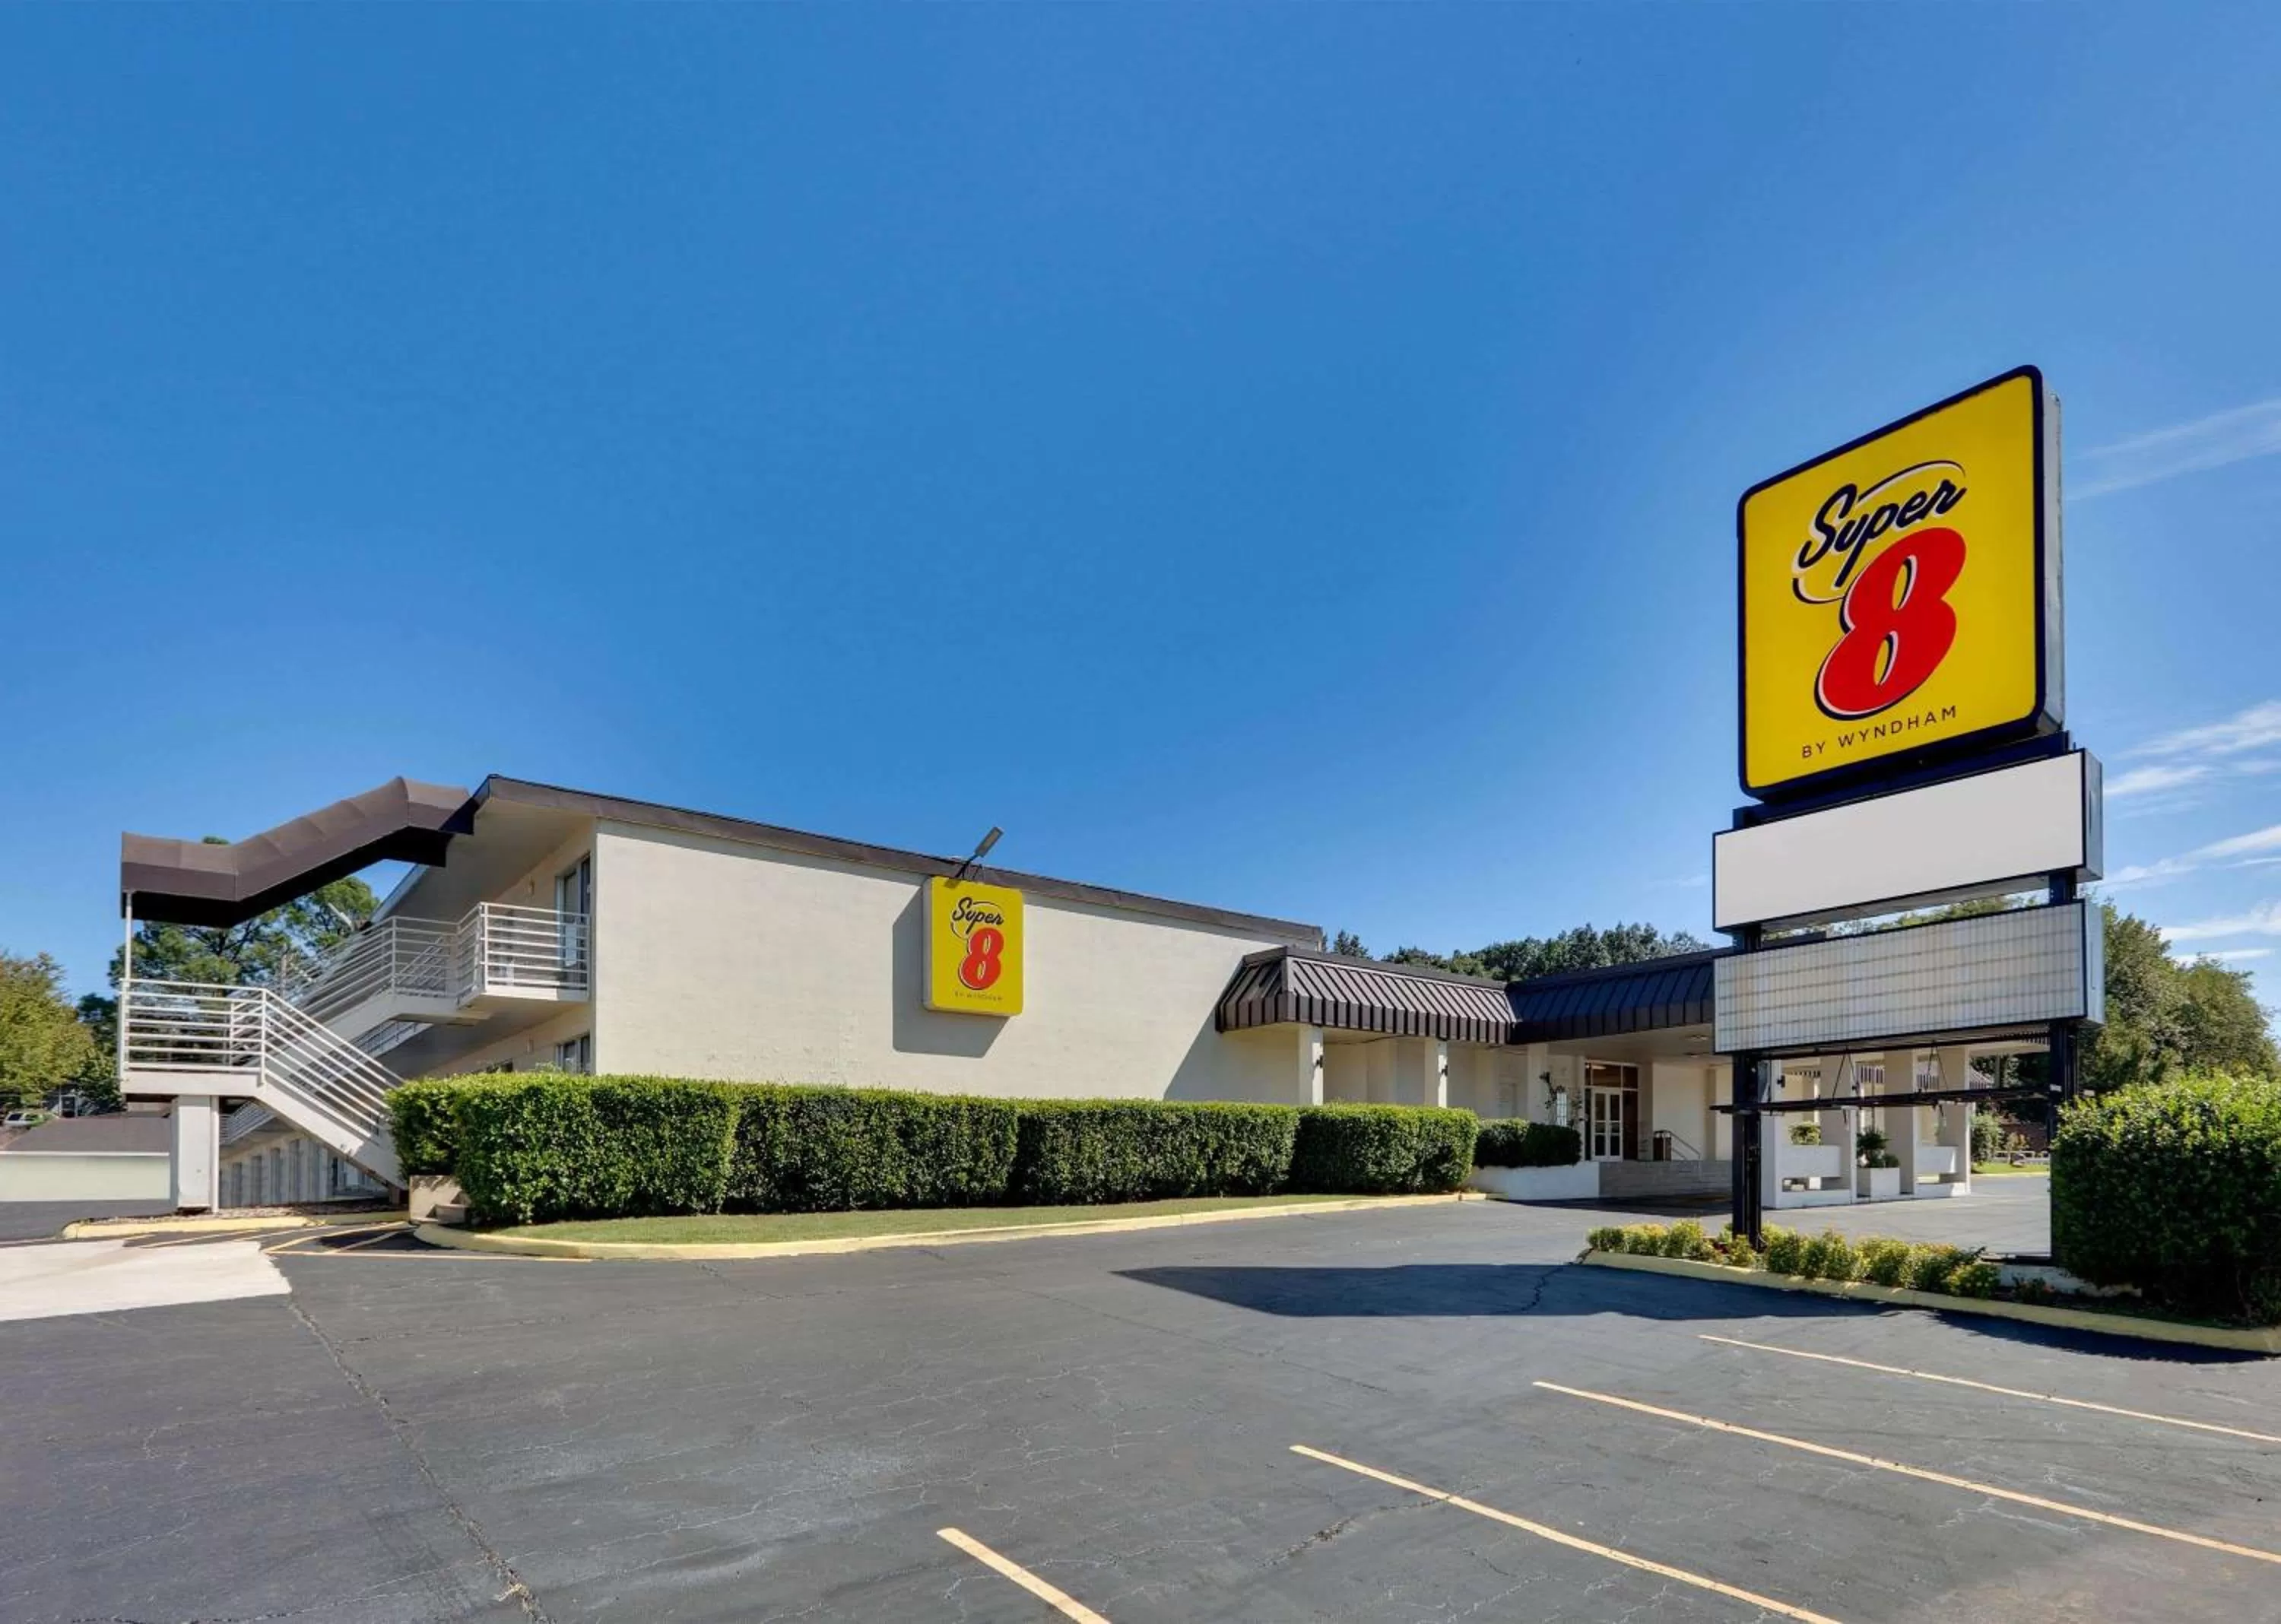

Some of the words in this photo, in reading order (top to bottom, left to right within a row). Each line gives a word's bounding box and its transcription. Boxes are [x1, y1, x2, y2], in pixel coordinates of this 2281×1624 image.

[1797, 479, 1967, 588] Super
[1813, 526, 1967, 721] 8
[1801, 741, 1826, 759] BY
[1837, 705, 1957, 749] WYNDHAM
[953, 897, 1004, 934] Super
[958, 928, 1004, 991] 8
